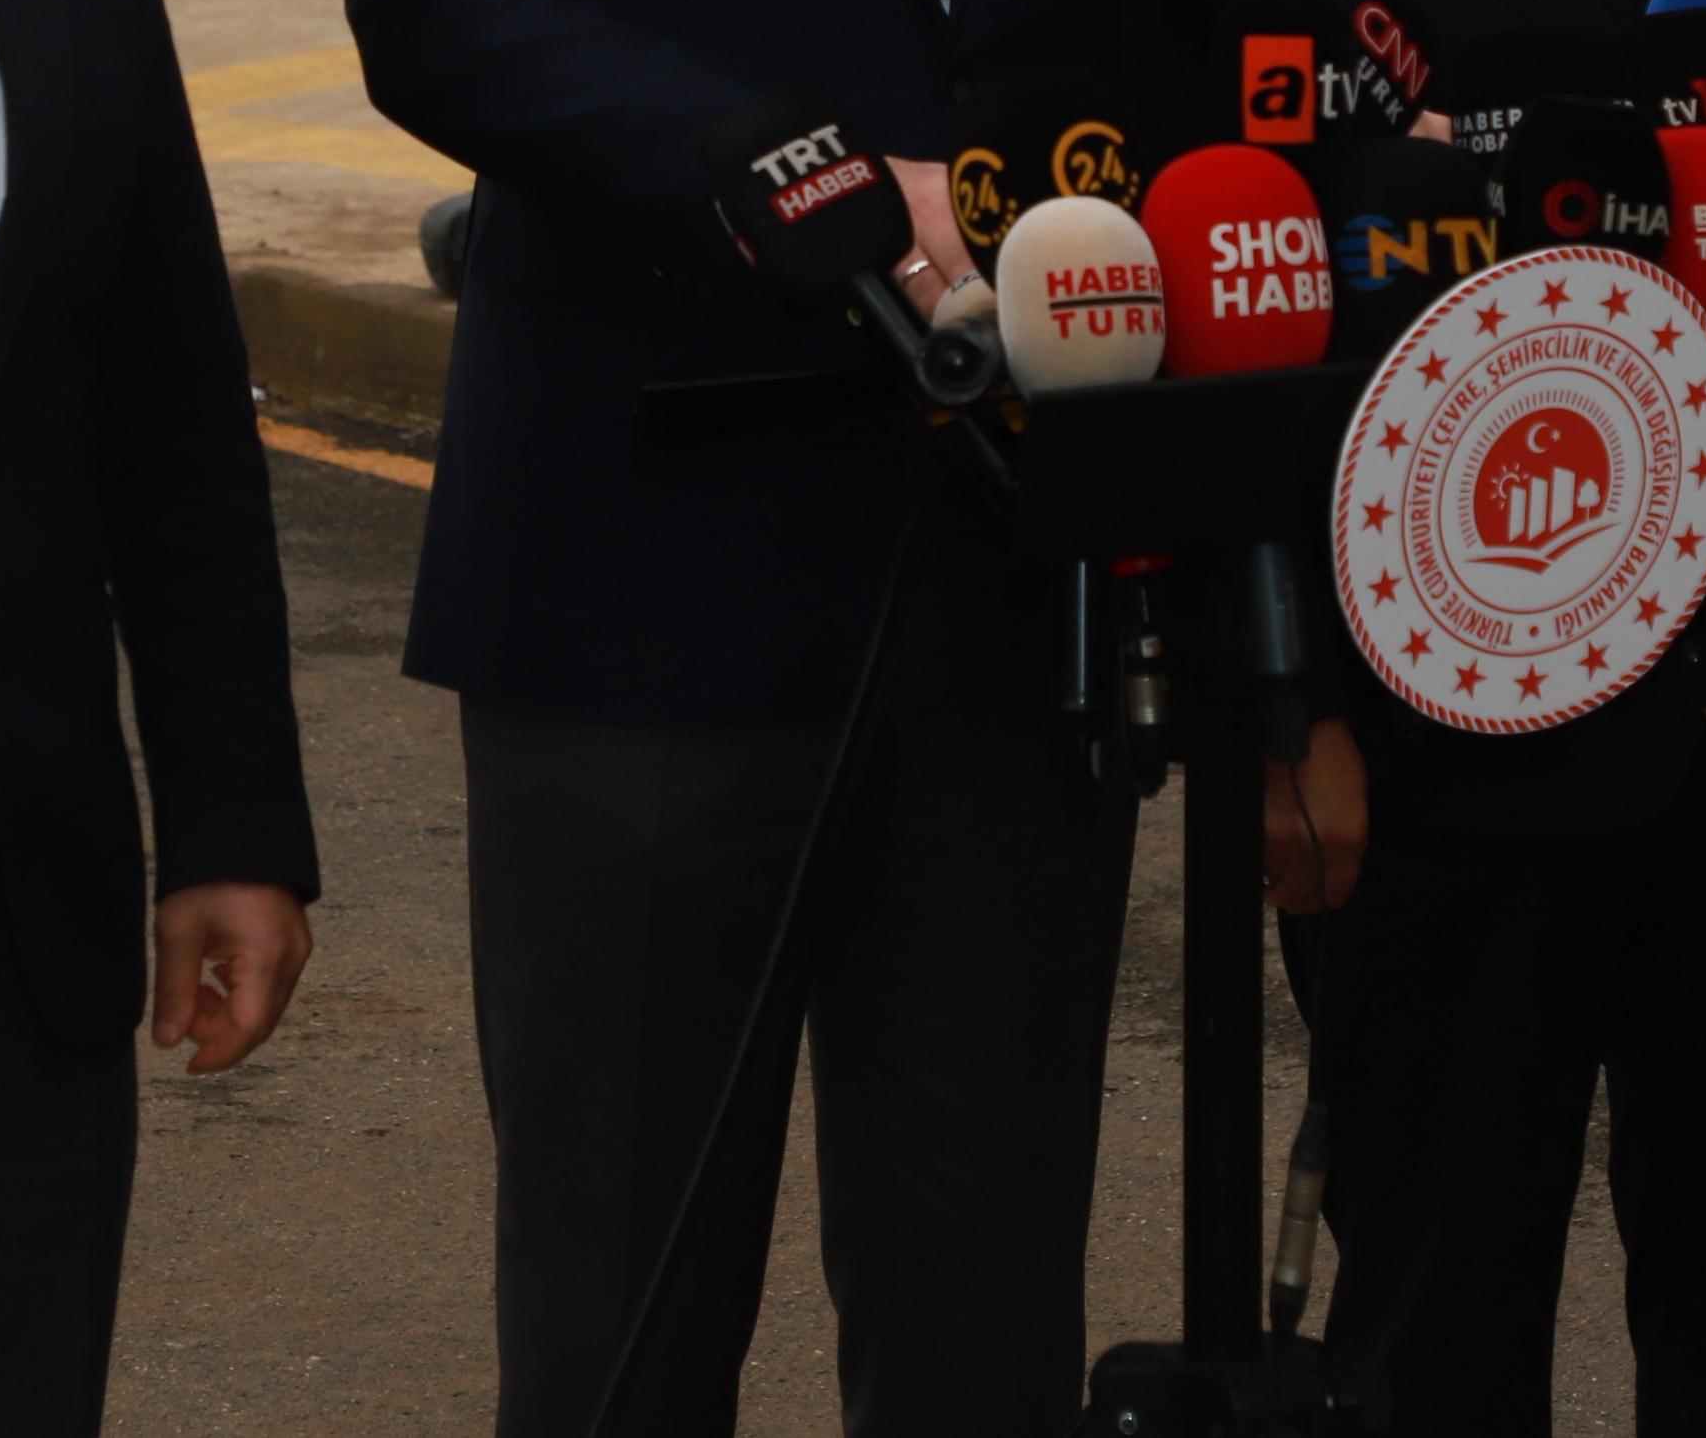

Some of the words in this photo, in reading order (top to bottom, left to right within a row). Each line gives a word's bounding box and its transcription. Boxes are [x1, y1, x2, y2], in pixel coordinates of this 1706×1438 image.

[1354, 0, 1432, 104] CNN
[750, 124, 846, 188] TRT
[778, 160, 874, 219] HABER
[1603, 194, 1670, 237] İHA
[1366, 219, 1496, 280] NTV
[1485, 329, 1593, 390] ŞEHİRCİLİK
[1595, 339, 1619, 372] VE
[1614, 350, 1660, 413] İKLİM
[1431, 379, 1489, 446] ÇEVRE,
[1640, 410, 1677, 546] DEĞİŞİKLİĞİ
[1407, 448, 1449, 601] CUMHURİYETİ
[1441, 589, 1514, 650] TÜRKİYE
[1555, 544, 1648, 640] BAKANLIĞI
